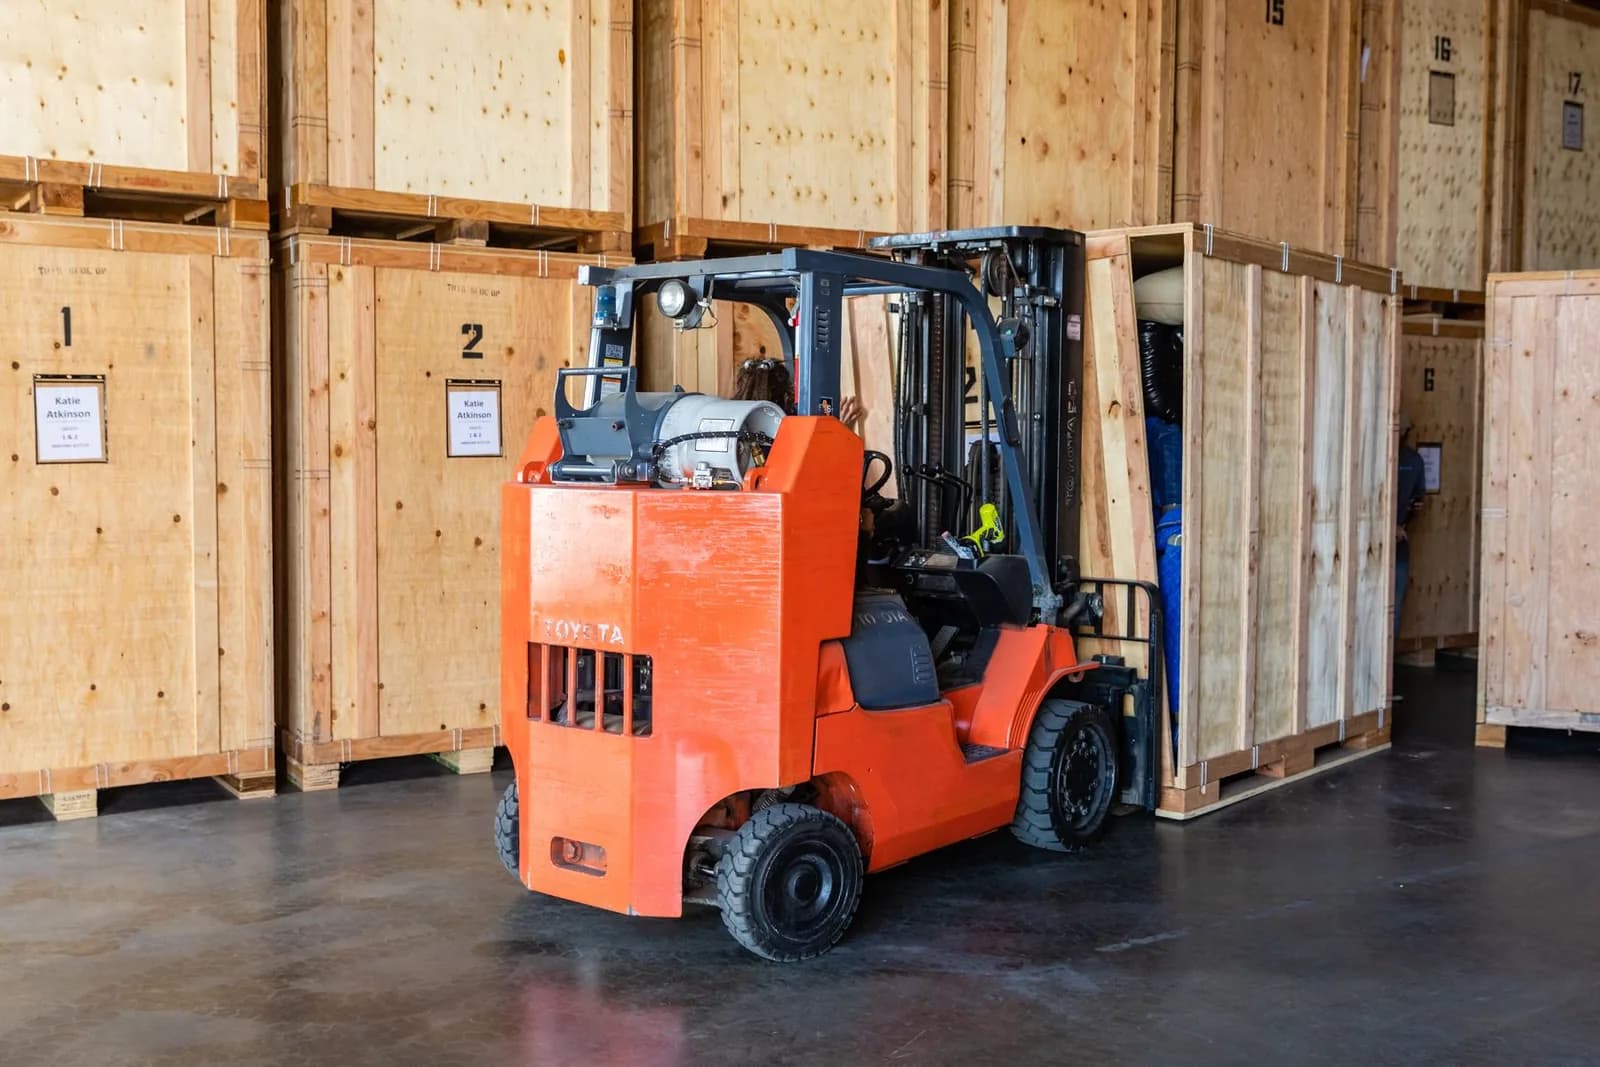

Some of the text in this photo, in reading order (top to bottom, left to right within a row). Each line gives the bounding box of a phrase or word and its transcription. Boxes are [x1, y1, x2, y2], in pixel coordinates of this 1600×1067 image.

[1266, 0, 1284, 25] 15
[1434, 35, 1451, 62] 16
[1568, 72, 1582, 96] 17
[61, 306, 72, 347] 1
[462, 323, 483, 359] 2
[1424, 367, 1435, 392] 6
[55, 397, 81, 405] Katie
[464, 400, 484, 408] Katie
[46, 410, 91, 419] Atkinson
[457, 411, 492, 419] Atkinson
